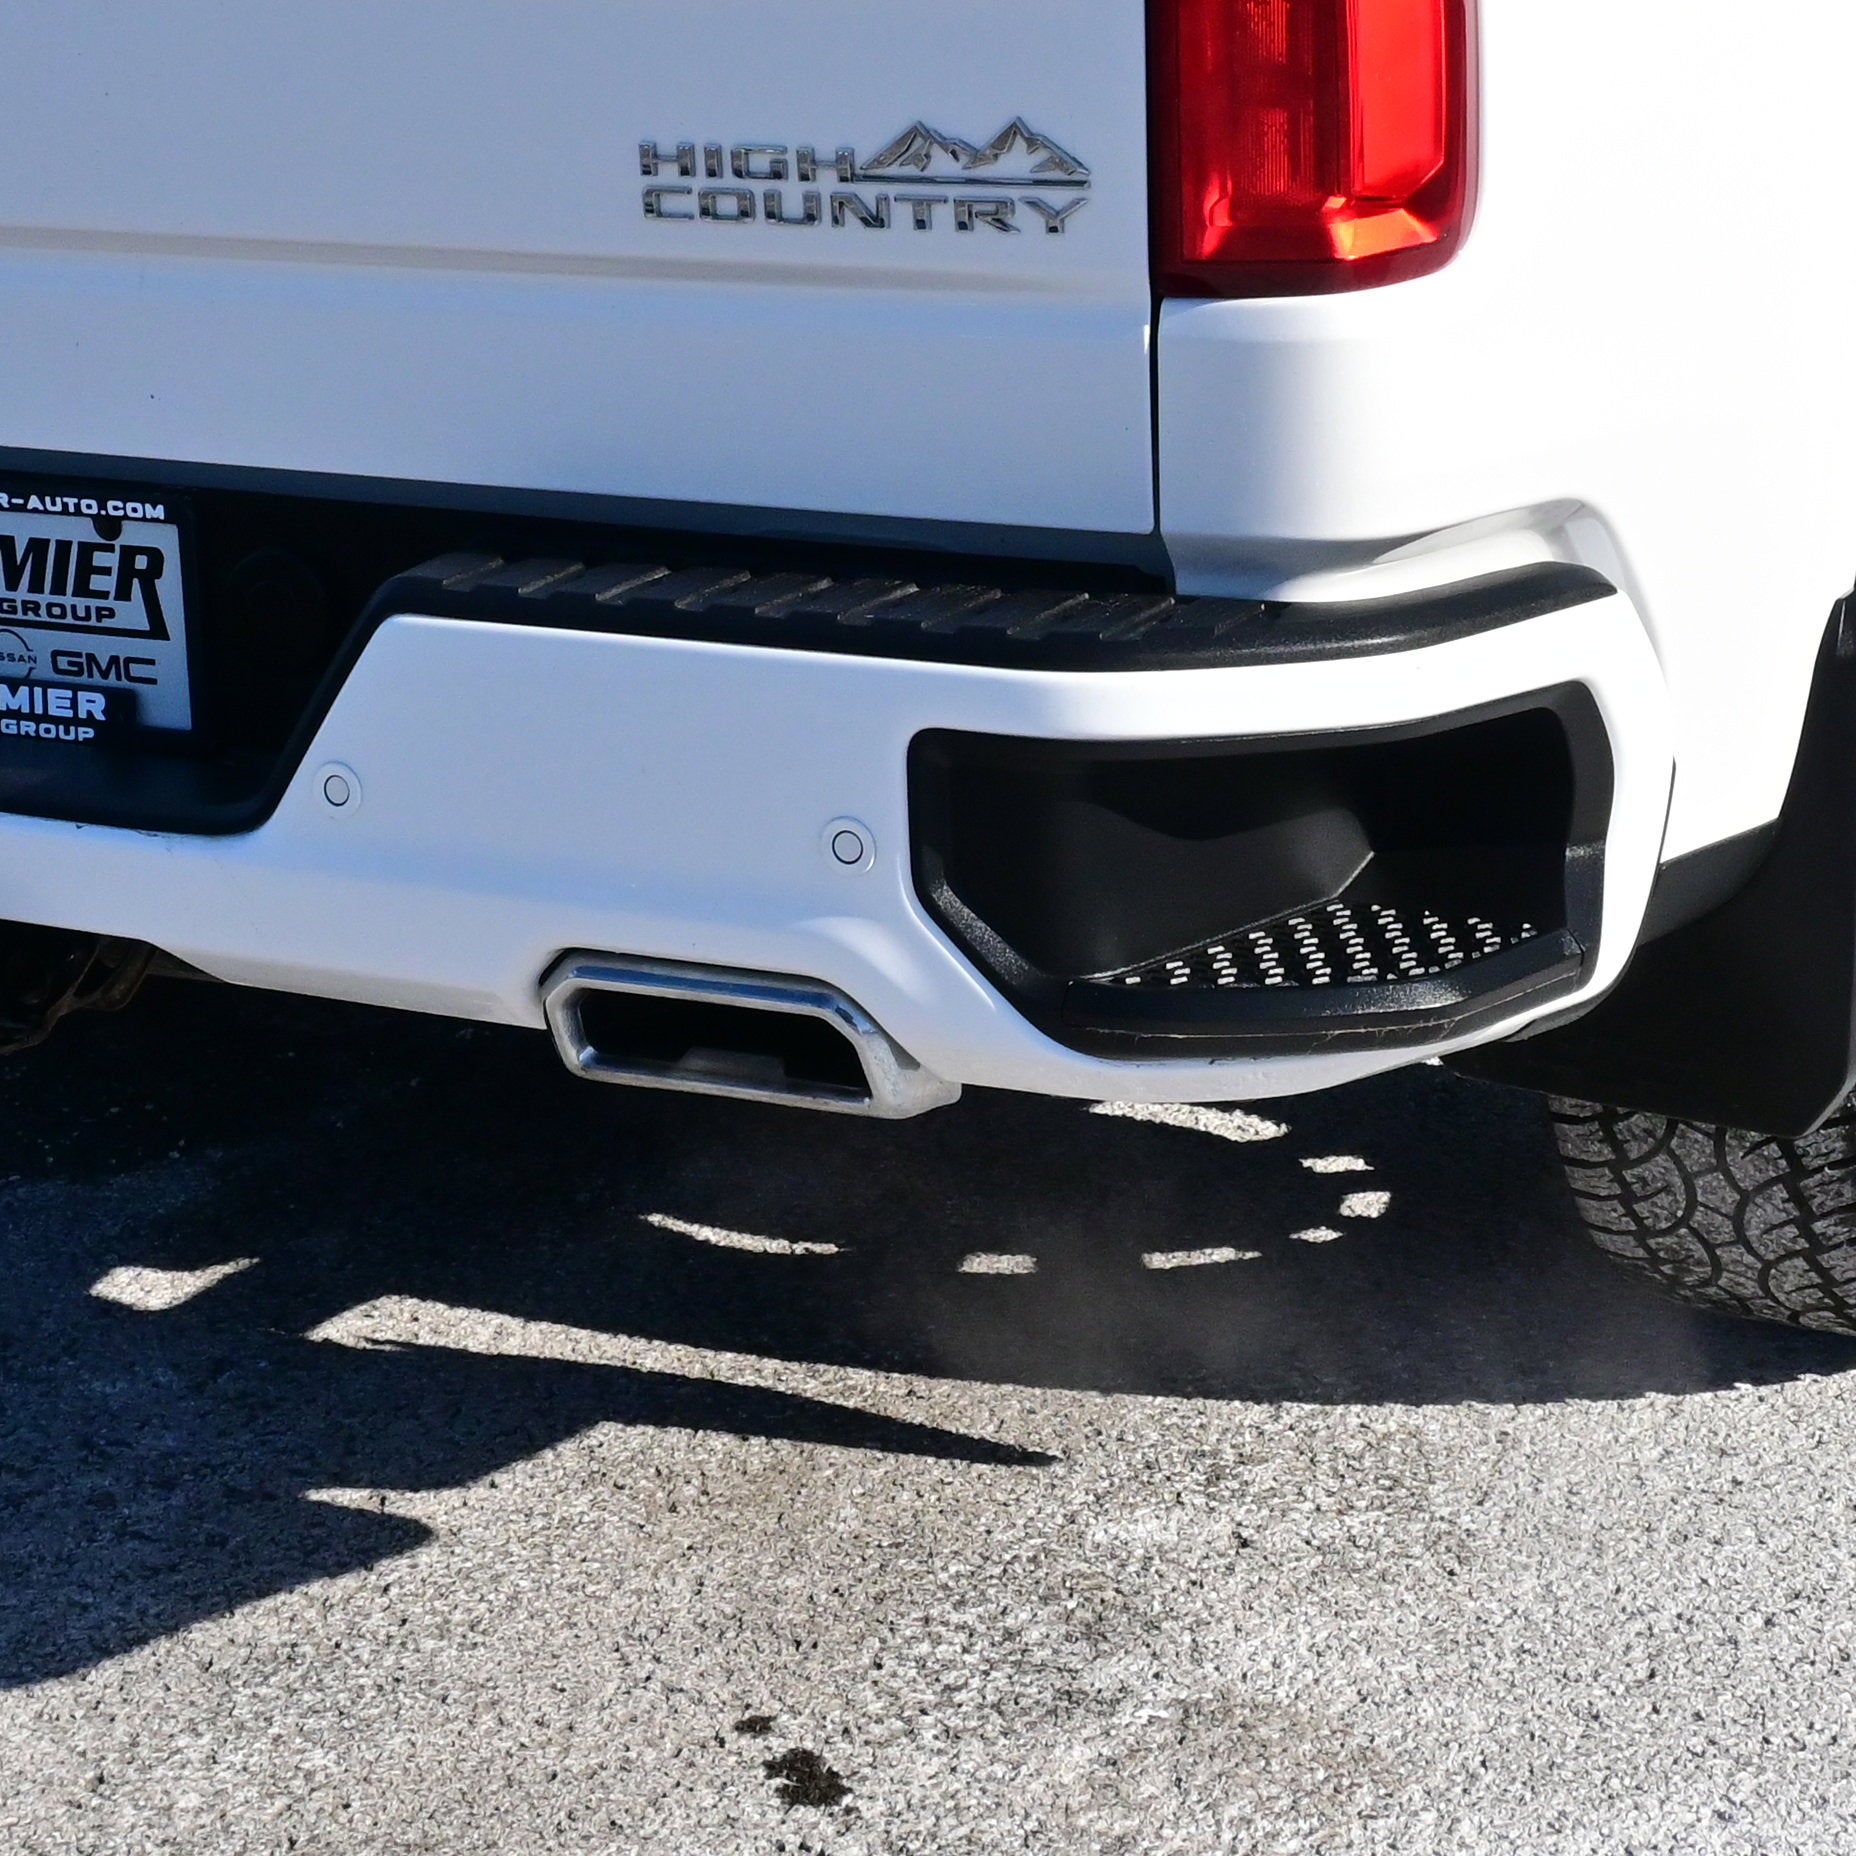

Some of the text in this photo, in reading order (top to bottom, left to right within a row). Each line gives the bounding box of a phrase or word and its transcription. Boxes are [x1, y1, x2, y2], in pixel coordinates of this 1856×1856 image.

[638, 141, 855, 183] HIGH
[641, 186, 1090, 234] COUNTRY
[49, 648, 158, 685] GMC
[0, 718, 95, 742] GROUP
